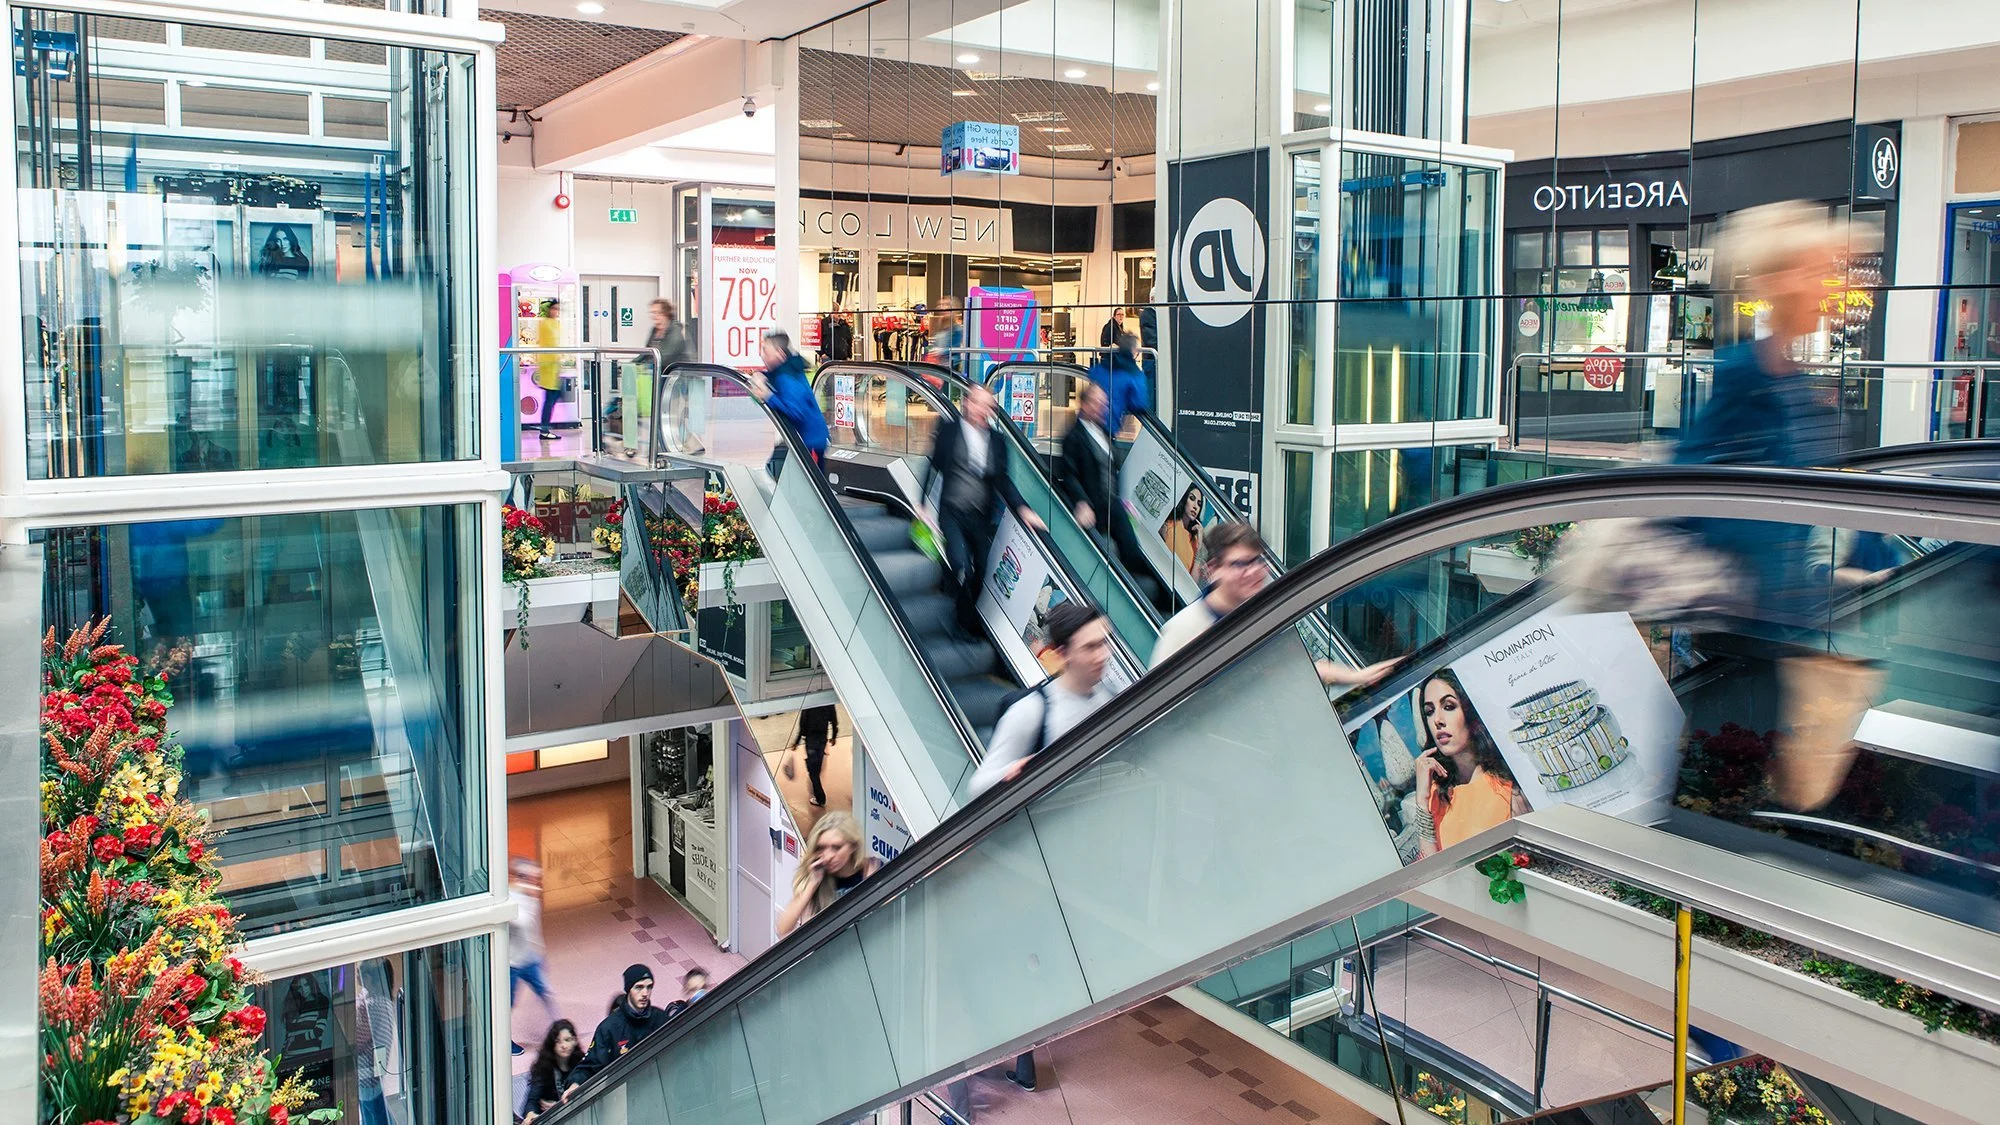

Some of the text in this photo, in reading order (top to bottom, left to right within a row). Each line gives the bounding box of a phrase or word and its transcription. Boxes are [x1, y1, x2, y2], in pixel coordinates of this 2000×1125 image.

[714, 255, 741, 264] FURTHER
[738, 267, 758, 275] NOW
[719, 277, 776, 322] 70%
[1483, 623, 1555, 668] NOMINATION
[1512, 648, 1534, 664] ITALY
[691, 853, 709, 869] SHOE
[696, 868, 707, 883] KEY
